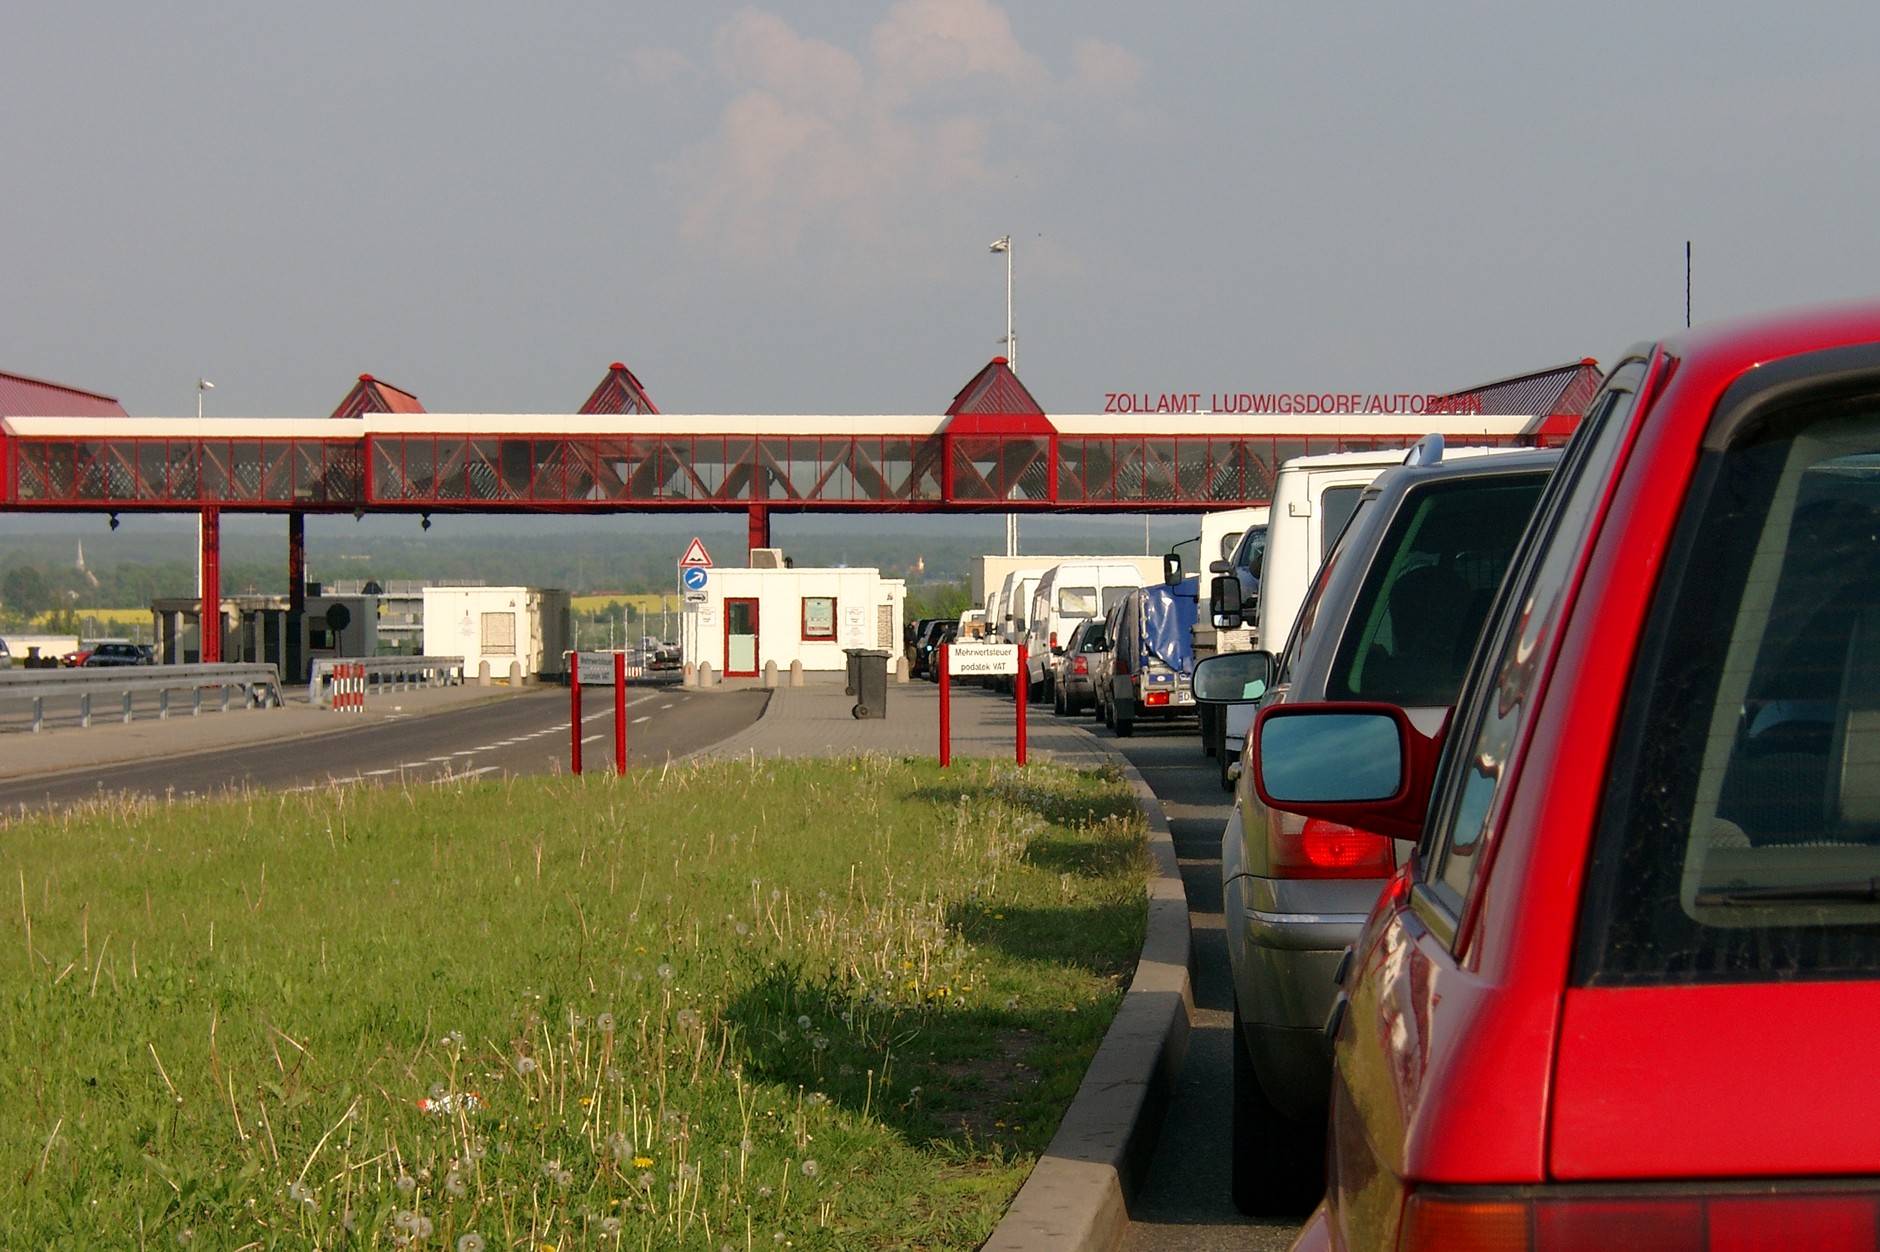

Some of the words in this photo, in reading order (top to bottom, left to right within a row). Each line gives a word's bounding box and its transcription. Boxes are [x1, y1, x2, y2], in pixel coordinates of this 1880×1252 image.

[1105, 393, 1201, 413] ZOLLAMT
[954, 648, 1012, 657] Mehrwertsteuer
[961, 662, 990, 672] podatek
[993, 662, 1006, 670] VAT
